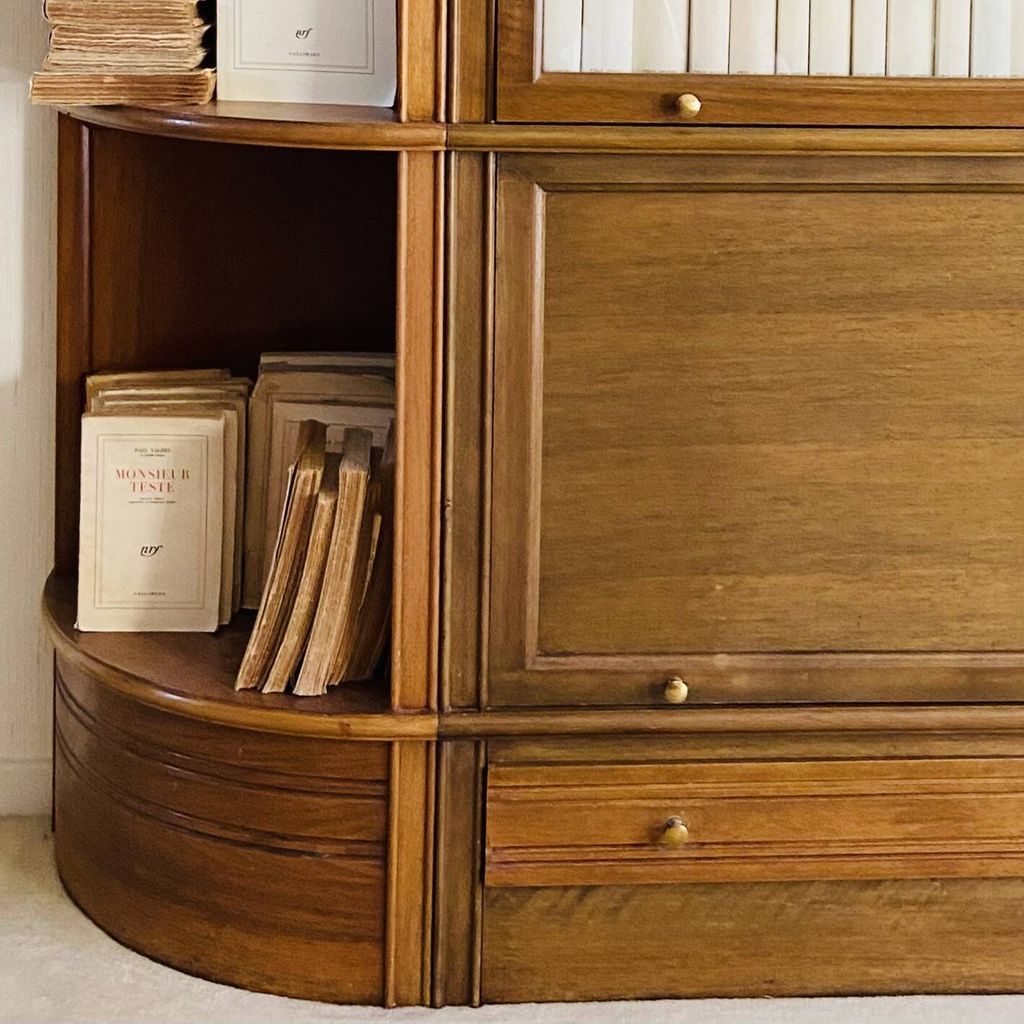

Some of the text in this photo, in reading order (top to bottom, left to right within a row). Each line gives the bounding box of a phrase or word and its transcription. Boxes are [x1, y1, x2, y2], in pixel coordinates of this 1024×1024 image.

[296, 28, 313, 40] nrf
[116, 468, 190, 480] MONSIEUR
[130, 481, 175, 493] TESTE
[140, 544, 164, 558] nrf
